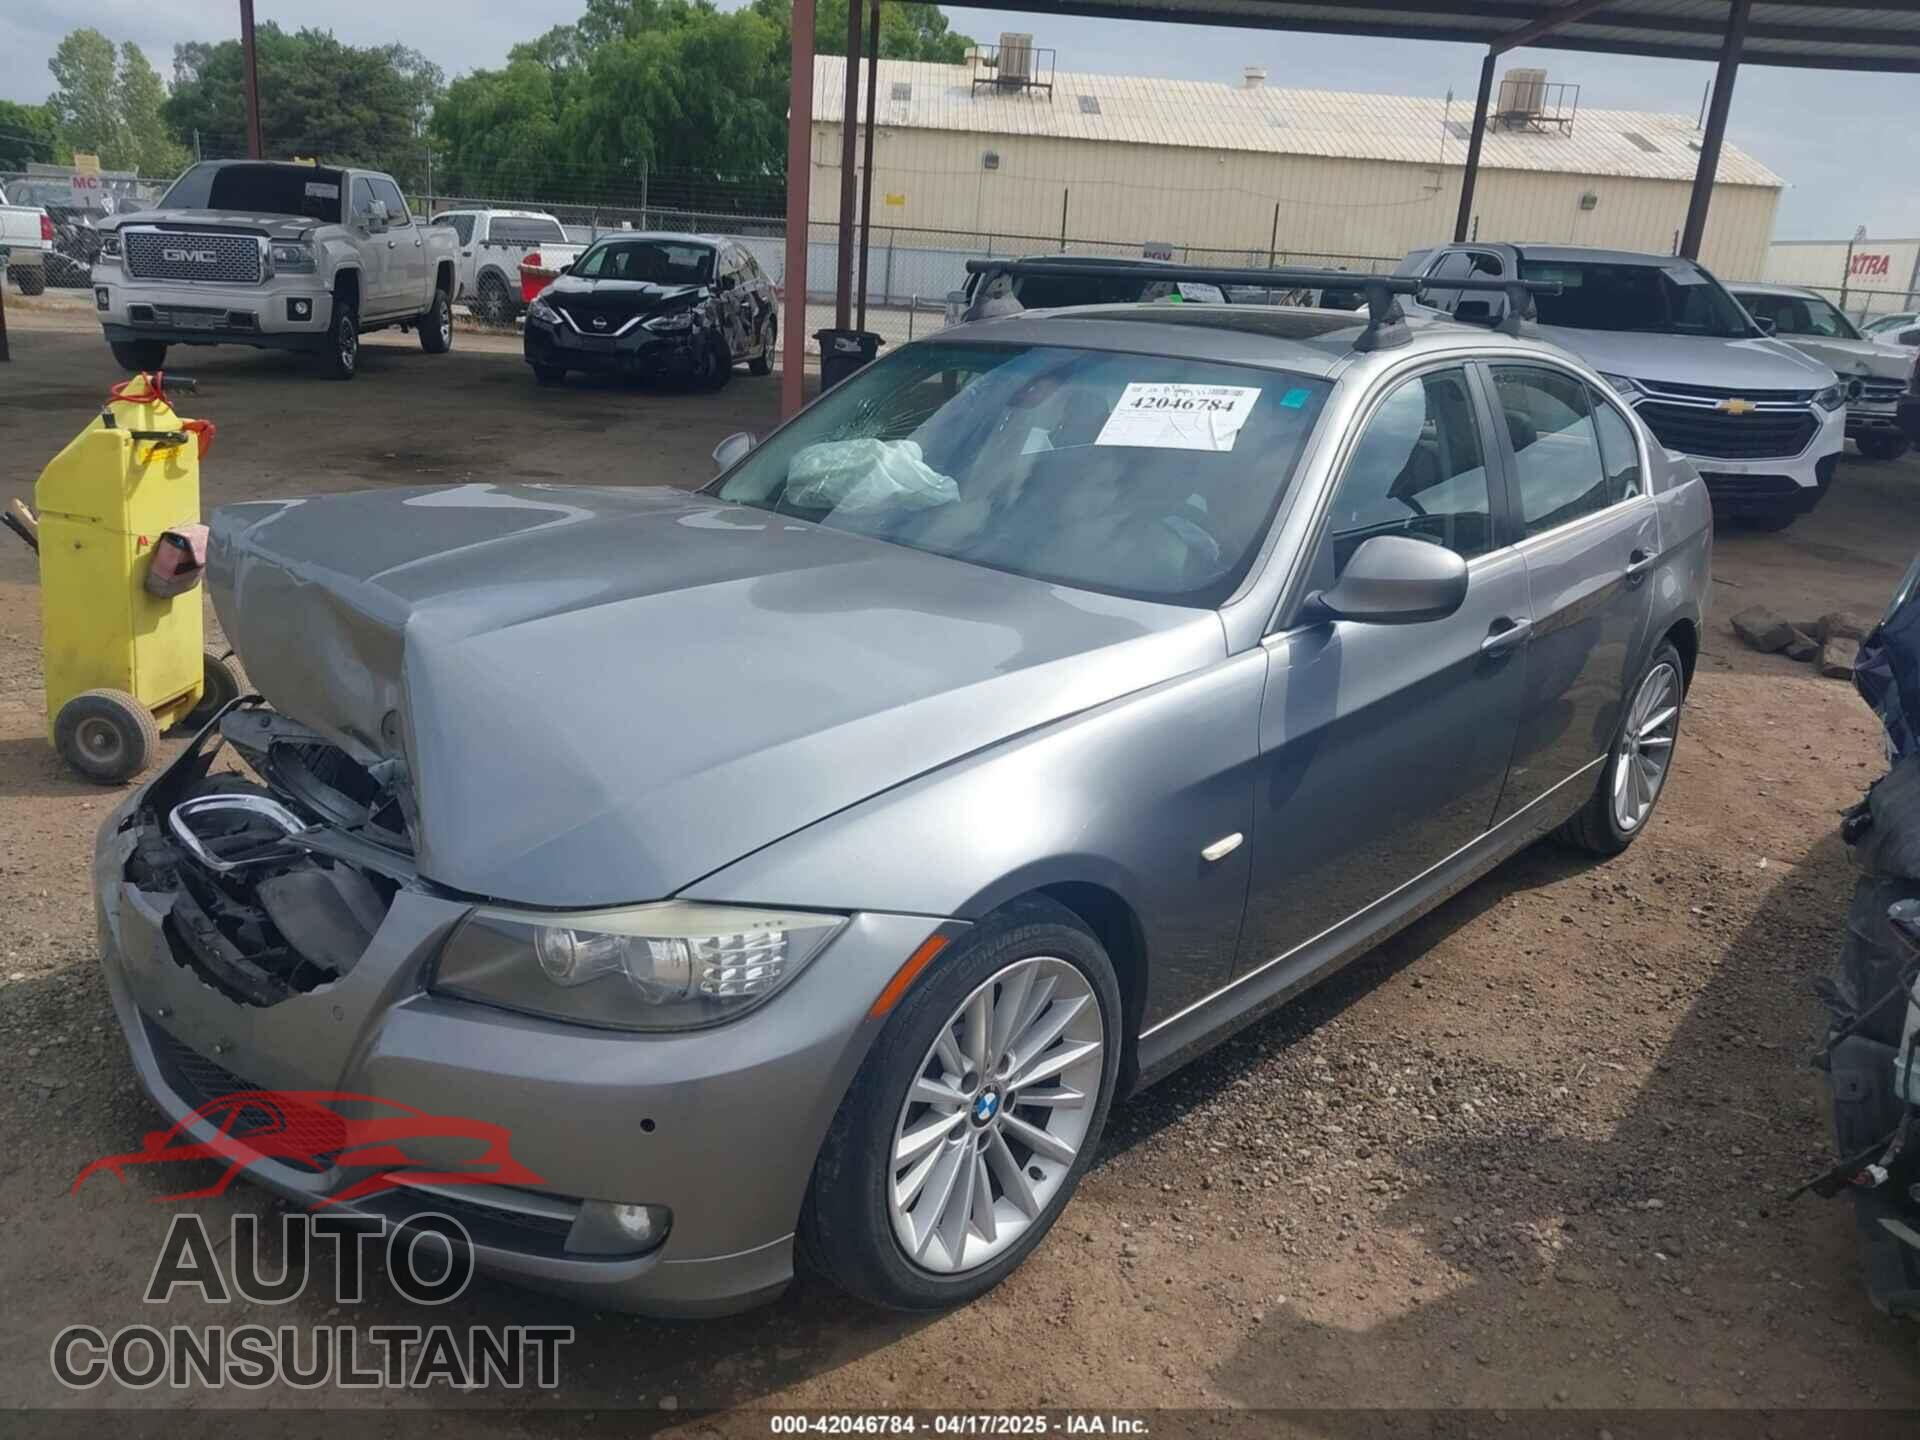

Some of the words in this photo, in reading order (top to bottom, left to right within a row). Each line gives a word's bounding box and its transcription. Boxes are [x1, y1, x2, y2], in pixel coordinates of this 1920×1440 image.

[73, 177, 97, 189] MC
[163, 249, 217, 262] GMC
[1129, 396, 1235, 412] 42046784
